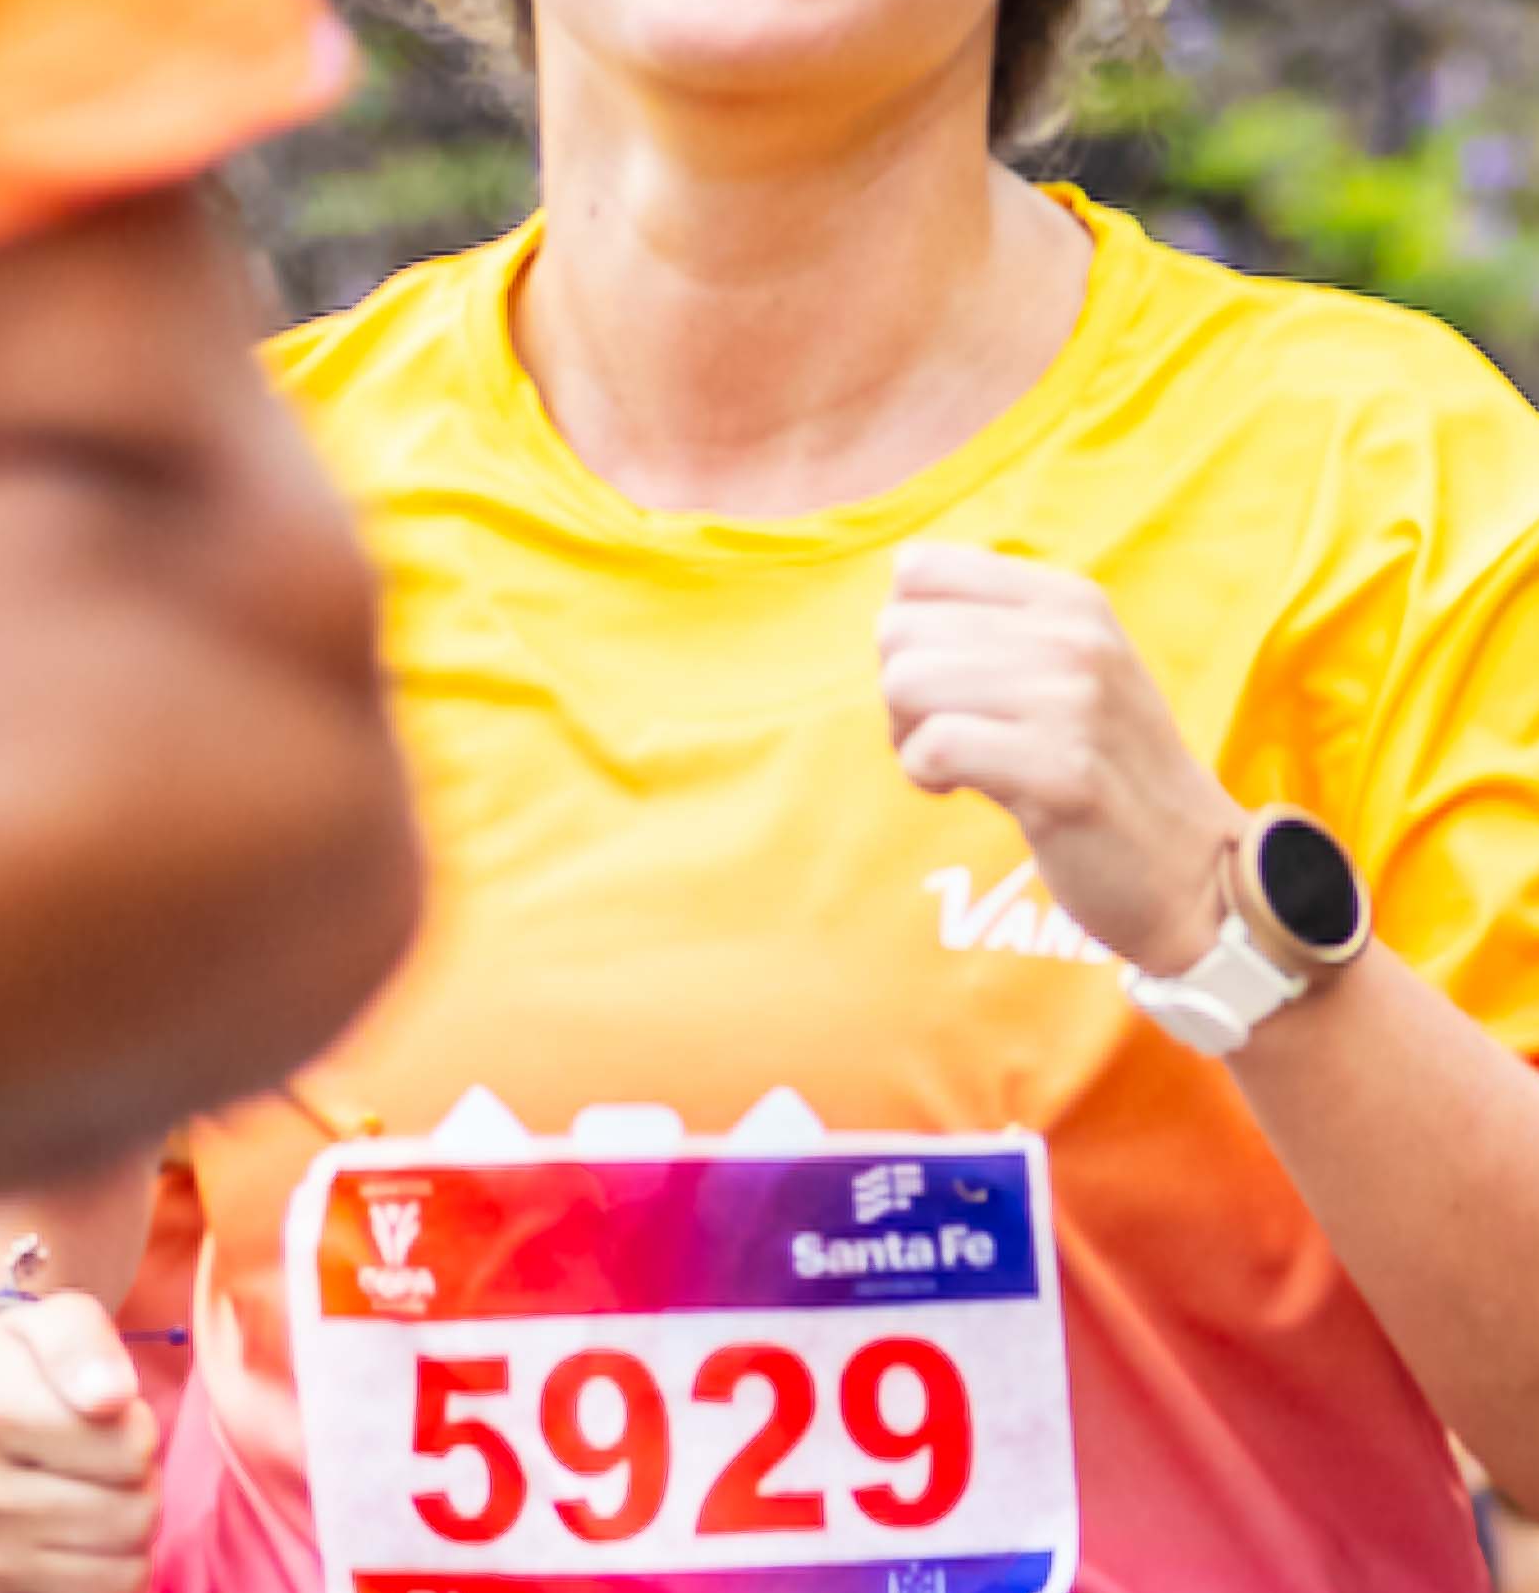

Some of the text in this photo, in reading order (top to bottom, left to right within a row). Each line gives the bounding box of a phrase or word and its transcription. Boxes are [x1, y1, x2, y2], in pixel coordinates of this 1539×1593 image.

[791, 1222, 996, 1279] Santa Fe
[409, 1335, 974, 1546] 5929
